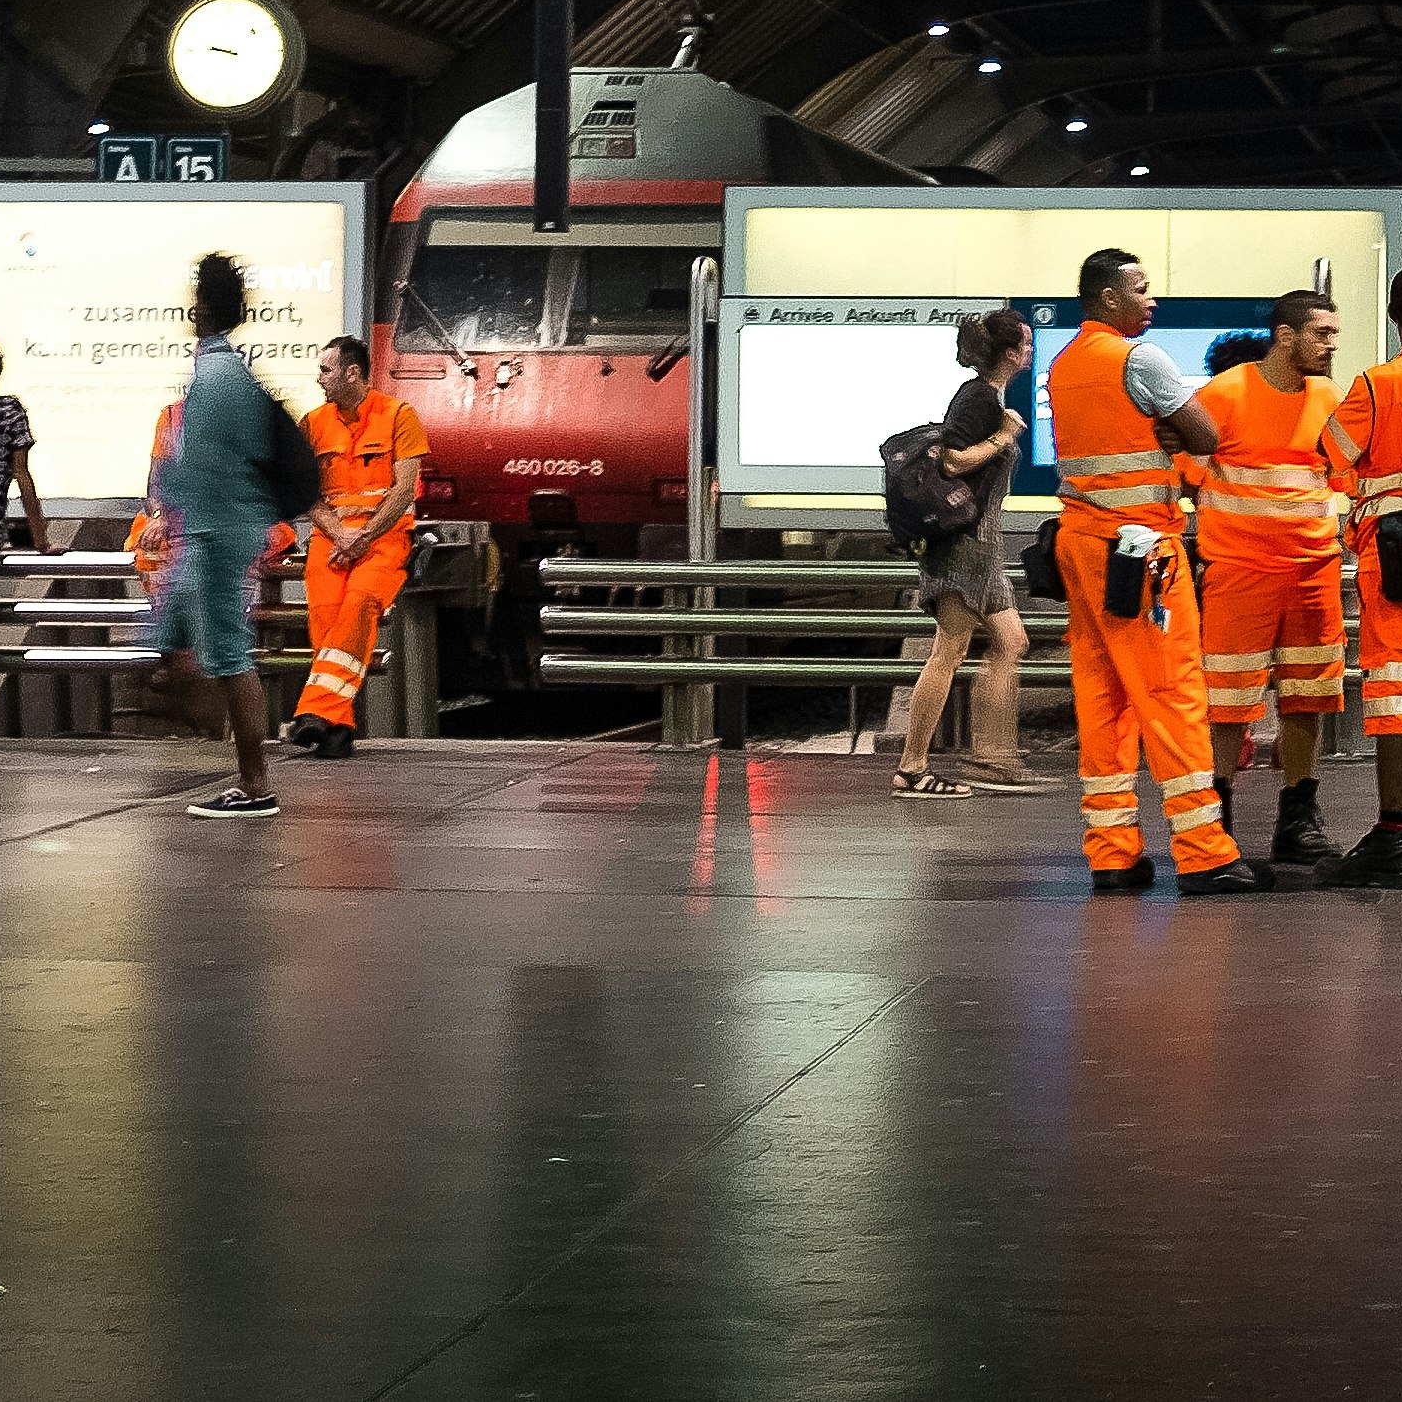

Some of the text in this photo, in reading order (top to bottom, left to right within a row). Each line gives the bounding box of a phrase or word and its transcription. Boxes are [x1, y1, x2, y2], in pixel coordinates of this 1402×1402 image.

[116, 154, 139, 181] A
[175, 155, 214, 181] 15
[769, 307, 834, 323] Arrivée
[845, 306, 917, 323] Ankunft
